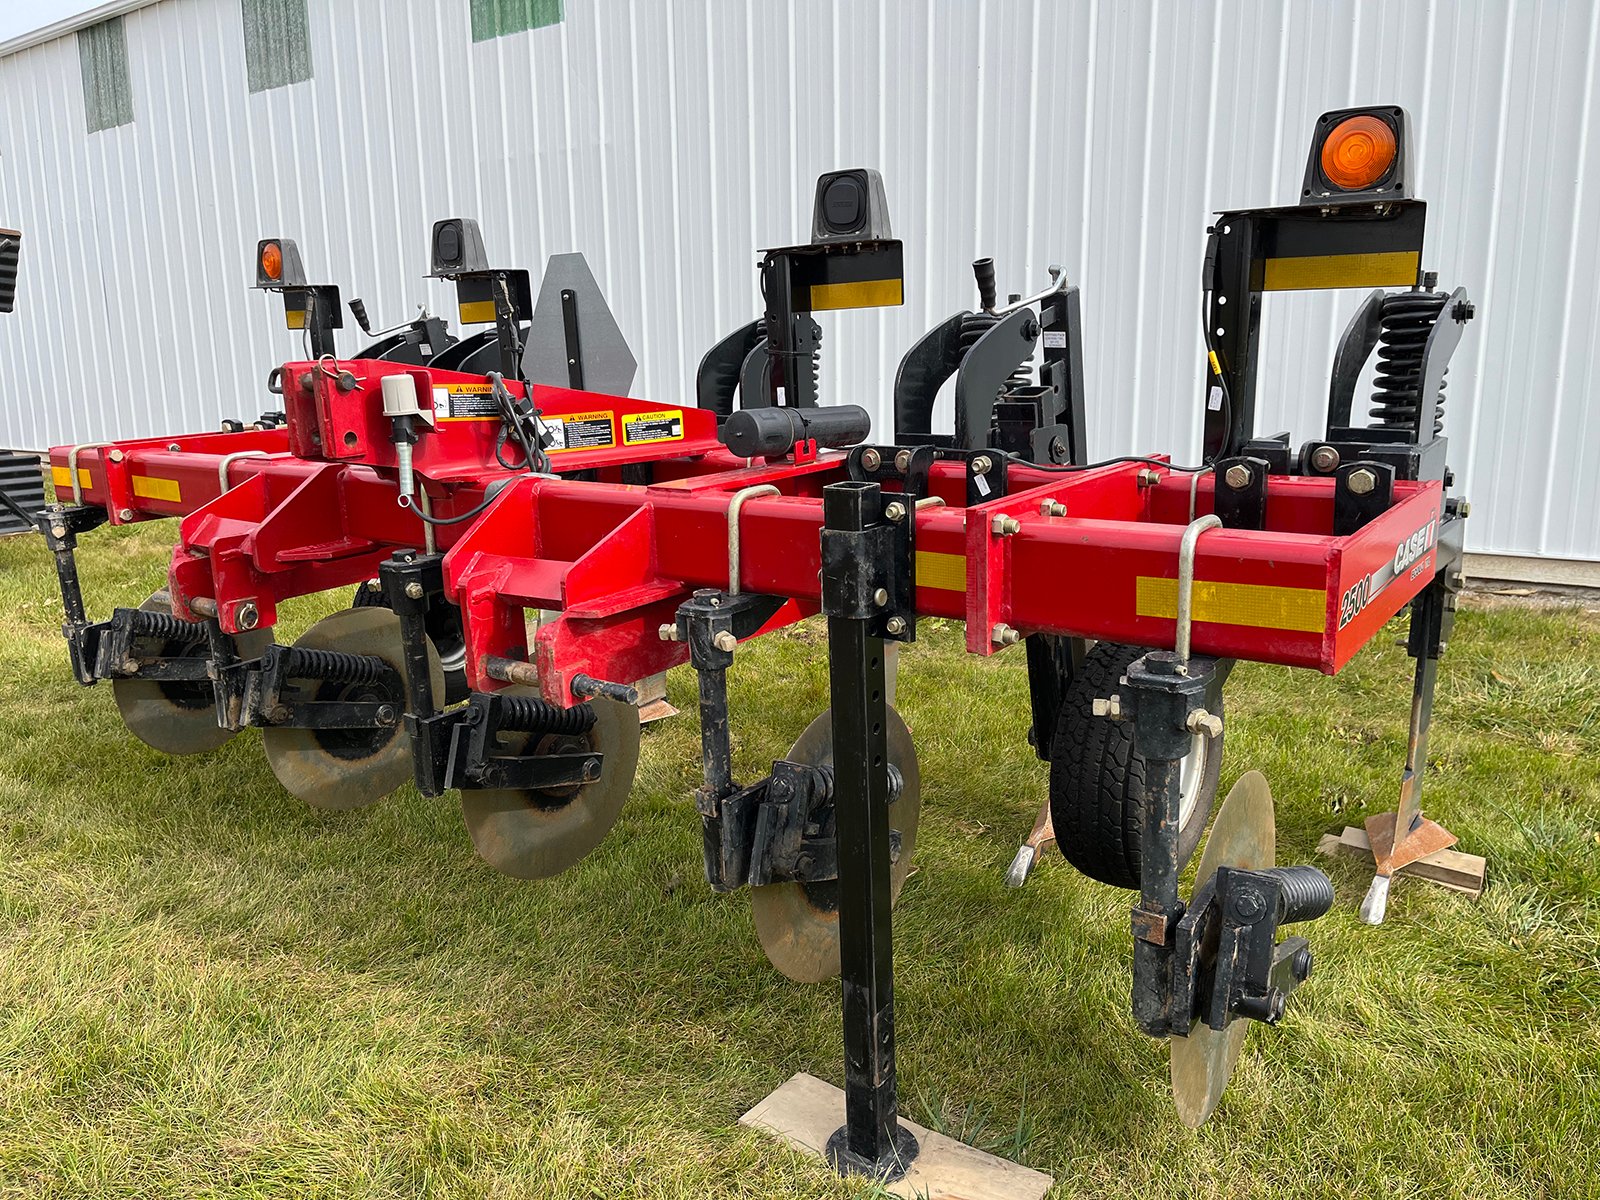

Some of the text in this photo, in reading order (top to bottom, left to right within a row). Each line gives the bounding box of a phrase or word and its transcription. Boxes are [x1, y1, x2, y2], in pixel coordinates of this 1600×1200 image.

[577, 412, 608, 421] WARNING
[641, 413, 666, 421] CAUTION
[1338, 572, 1371, 632] 2500
